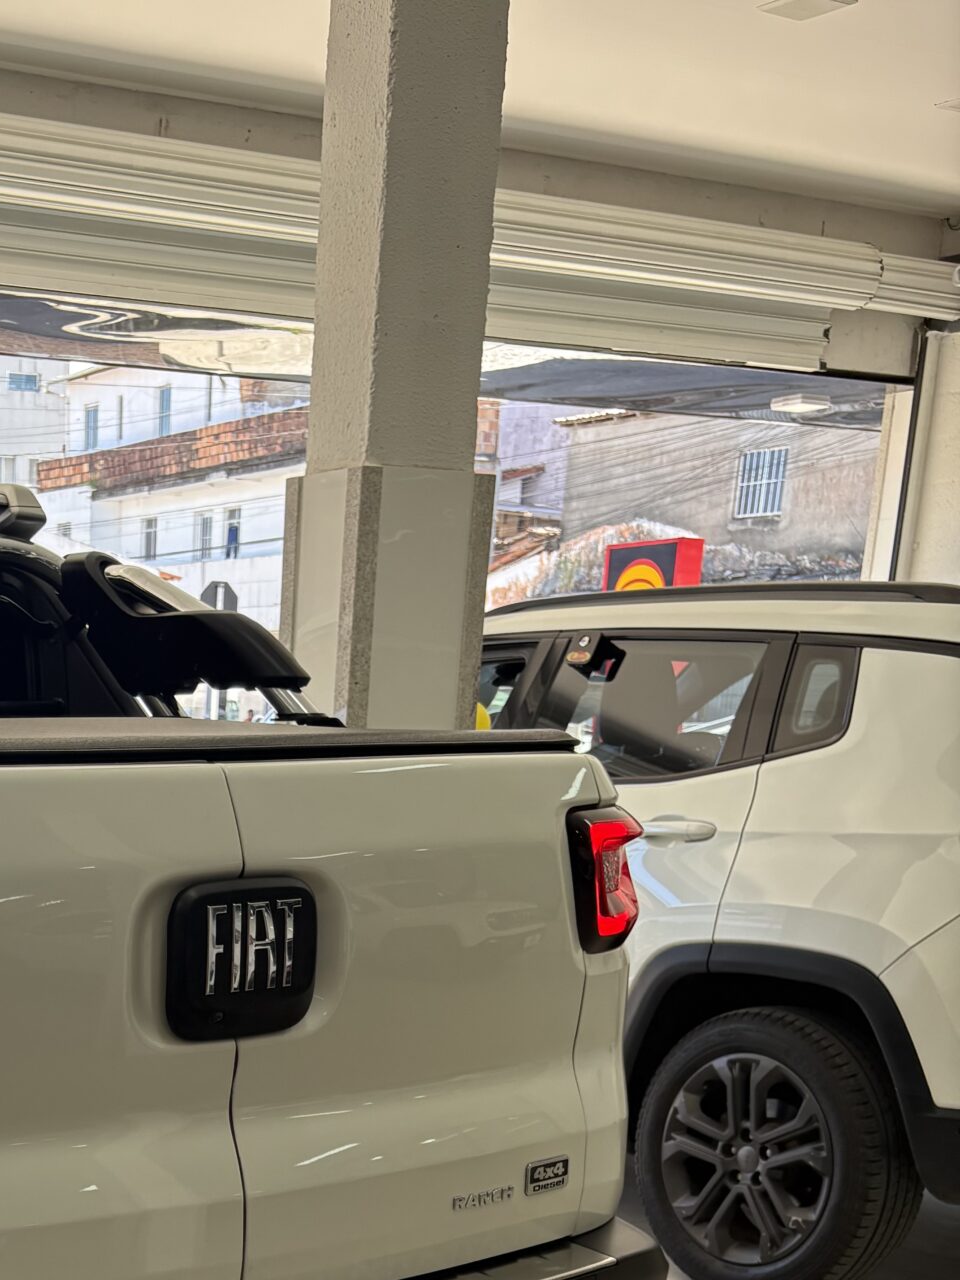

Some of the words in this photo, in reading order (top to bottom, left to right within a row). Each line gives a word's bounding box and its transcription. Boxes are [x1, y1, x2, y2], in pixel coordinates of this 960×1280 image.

[205, 898, 302, 995] FIAT
[533, 1161, 565, 1180] 4x4
[533, 1177, 565, 1192] Diesel
